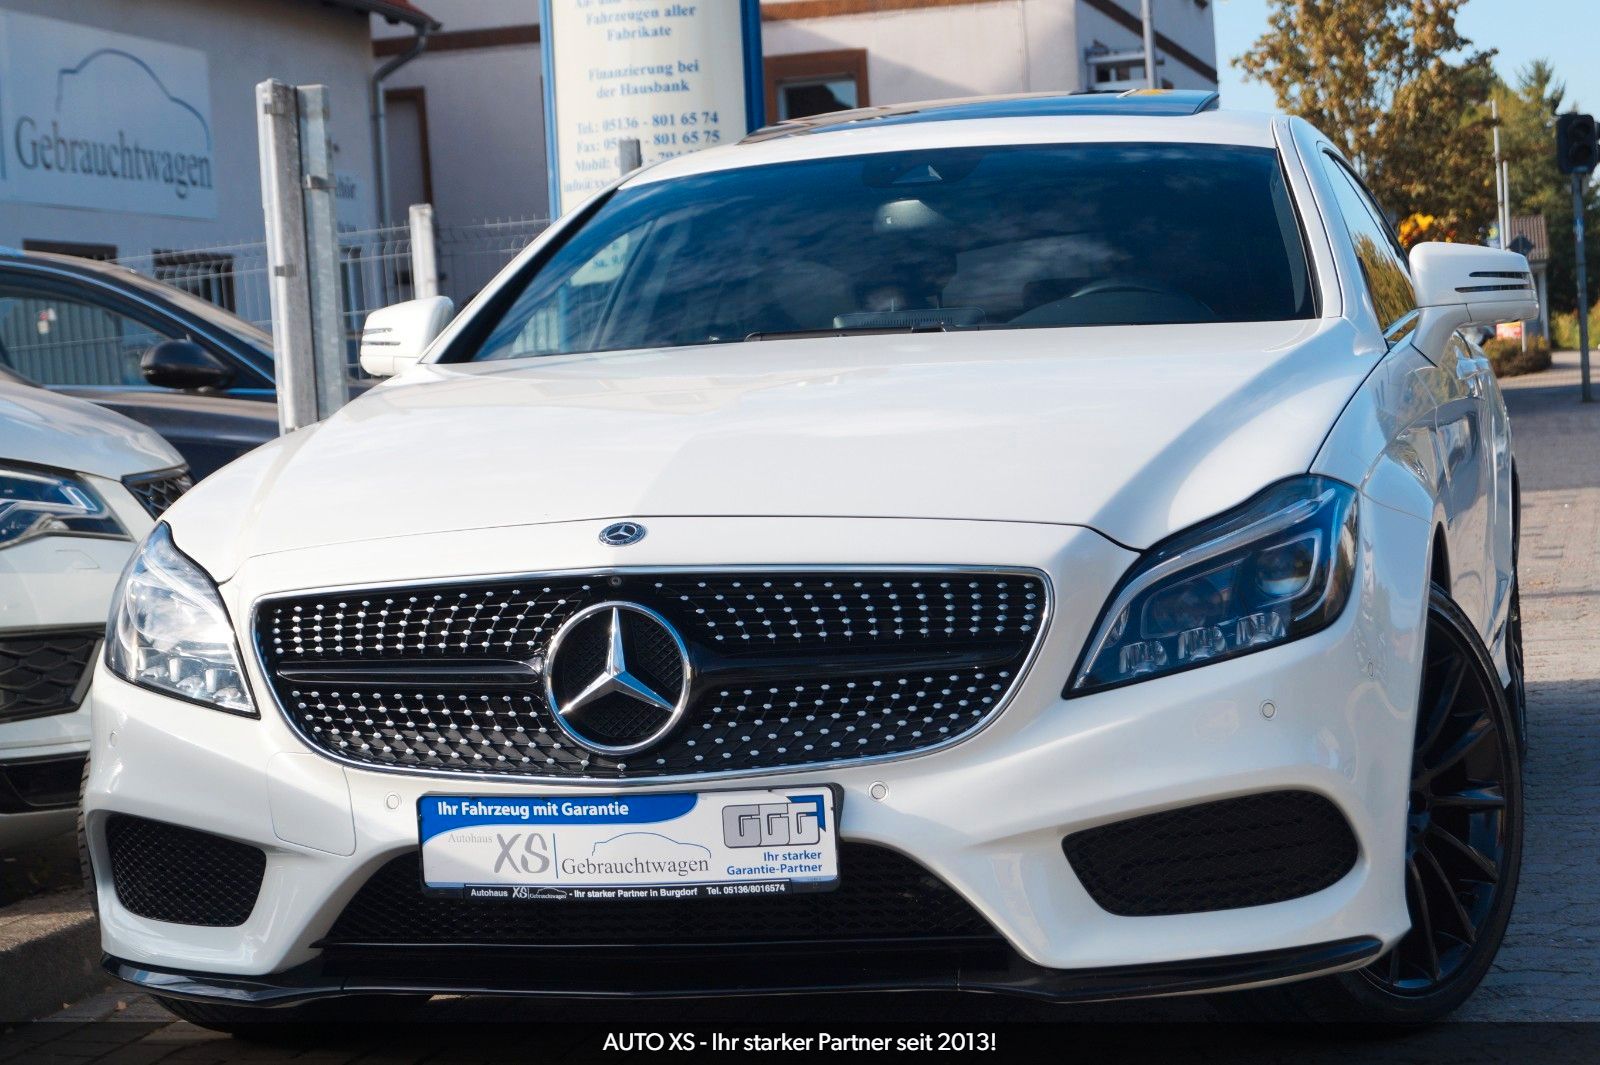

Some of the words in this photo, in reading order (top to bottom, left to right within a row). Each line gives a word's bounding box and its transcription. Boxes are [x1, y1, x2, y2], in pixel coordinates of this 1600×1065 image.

[586, 8, 659, 25] Fahrzeugen
[664, 4, 696, 18] aller
[607, 26, 672, 41] Fabrikate
[588, 62, 673, 80] Finanzierung
[678, 59, 699, 73] bei
[596, 86, 616, 98] der
[620, 80, 690, 96] Hausbank
[652, 113, 675, 126] 801
[681, 112, 697, 124] 65
[702, 111, 719, 124] 74
[653, 132, 677, 145] 801
[682, 131, 698, 144] 65
[703, 130, 720, 143] 75
[15, 116, 213, 199] Gebrauchtwagen
[437, 802, 458, 816] Ihr
[462, 802, 530, 819] Fahrzeug
[533, 802, 559, 816] mit
[562, 802, 629, 817] Garantie
[448, 833, 493, 844] Autohaus
[493, 833, 550, 874] XS
[562, 857, 710, 877] Gebrauchtwagen
[763, 852, 779, 862] Ihr
[782, 850, 822, 861] starker
[726, 863, 822, 875] Garantie-Partner
[471, 889, 508, 897] Autohaus
[513, 887, 528, 899] XS
[574, 889, 586, 897] Ihr
[587, 889, 616, 898] starker
[617, 889, 648, 898] Partner
[650, 889, 658, 897] in
[660, 888, 698, 899] Burgdorf
[706, 886, 722, 895] Tel.
[723, 884, 786, 895] 05136/8016574
